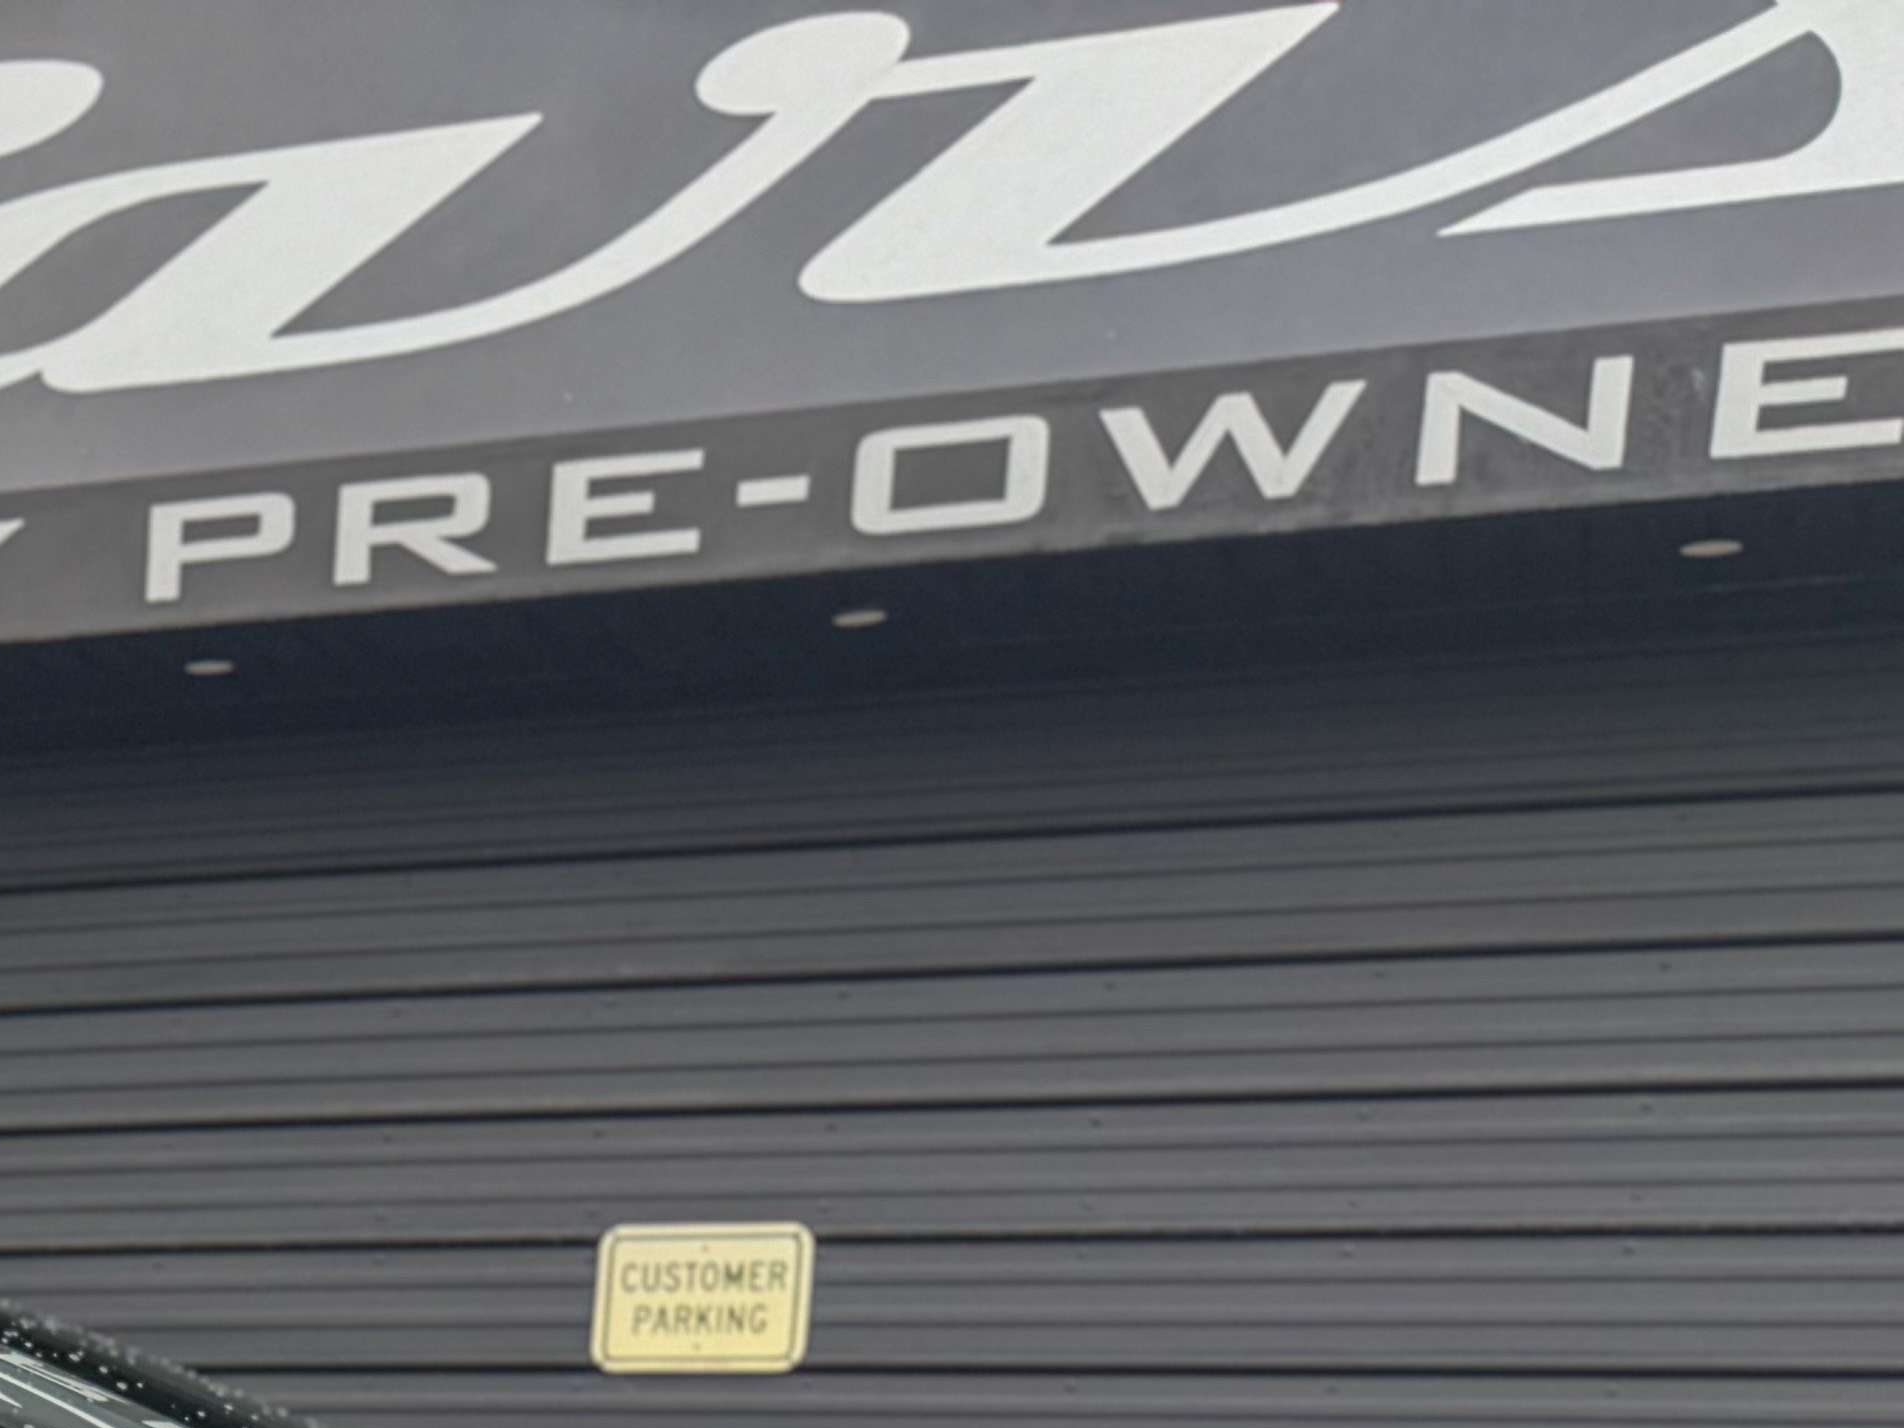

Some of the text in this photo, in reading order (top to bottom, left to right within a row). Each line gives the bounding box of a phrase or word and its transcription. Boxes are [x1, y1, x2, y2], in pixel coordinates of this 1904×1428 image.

[143, 328, 1904, 603] PRE-OWNE
[619, 1259, 789, 1294] CUSTOMER
[630, 1303, 769, 1336] PARKING
